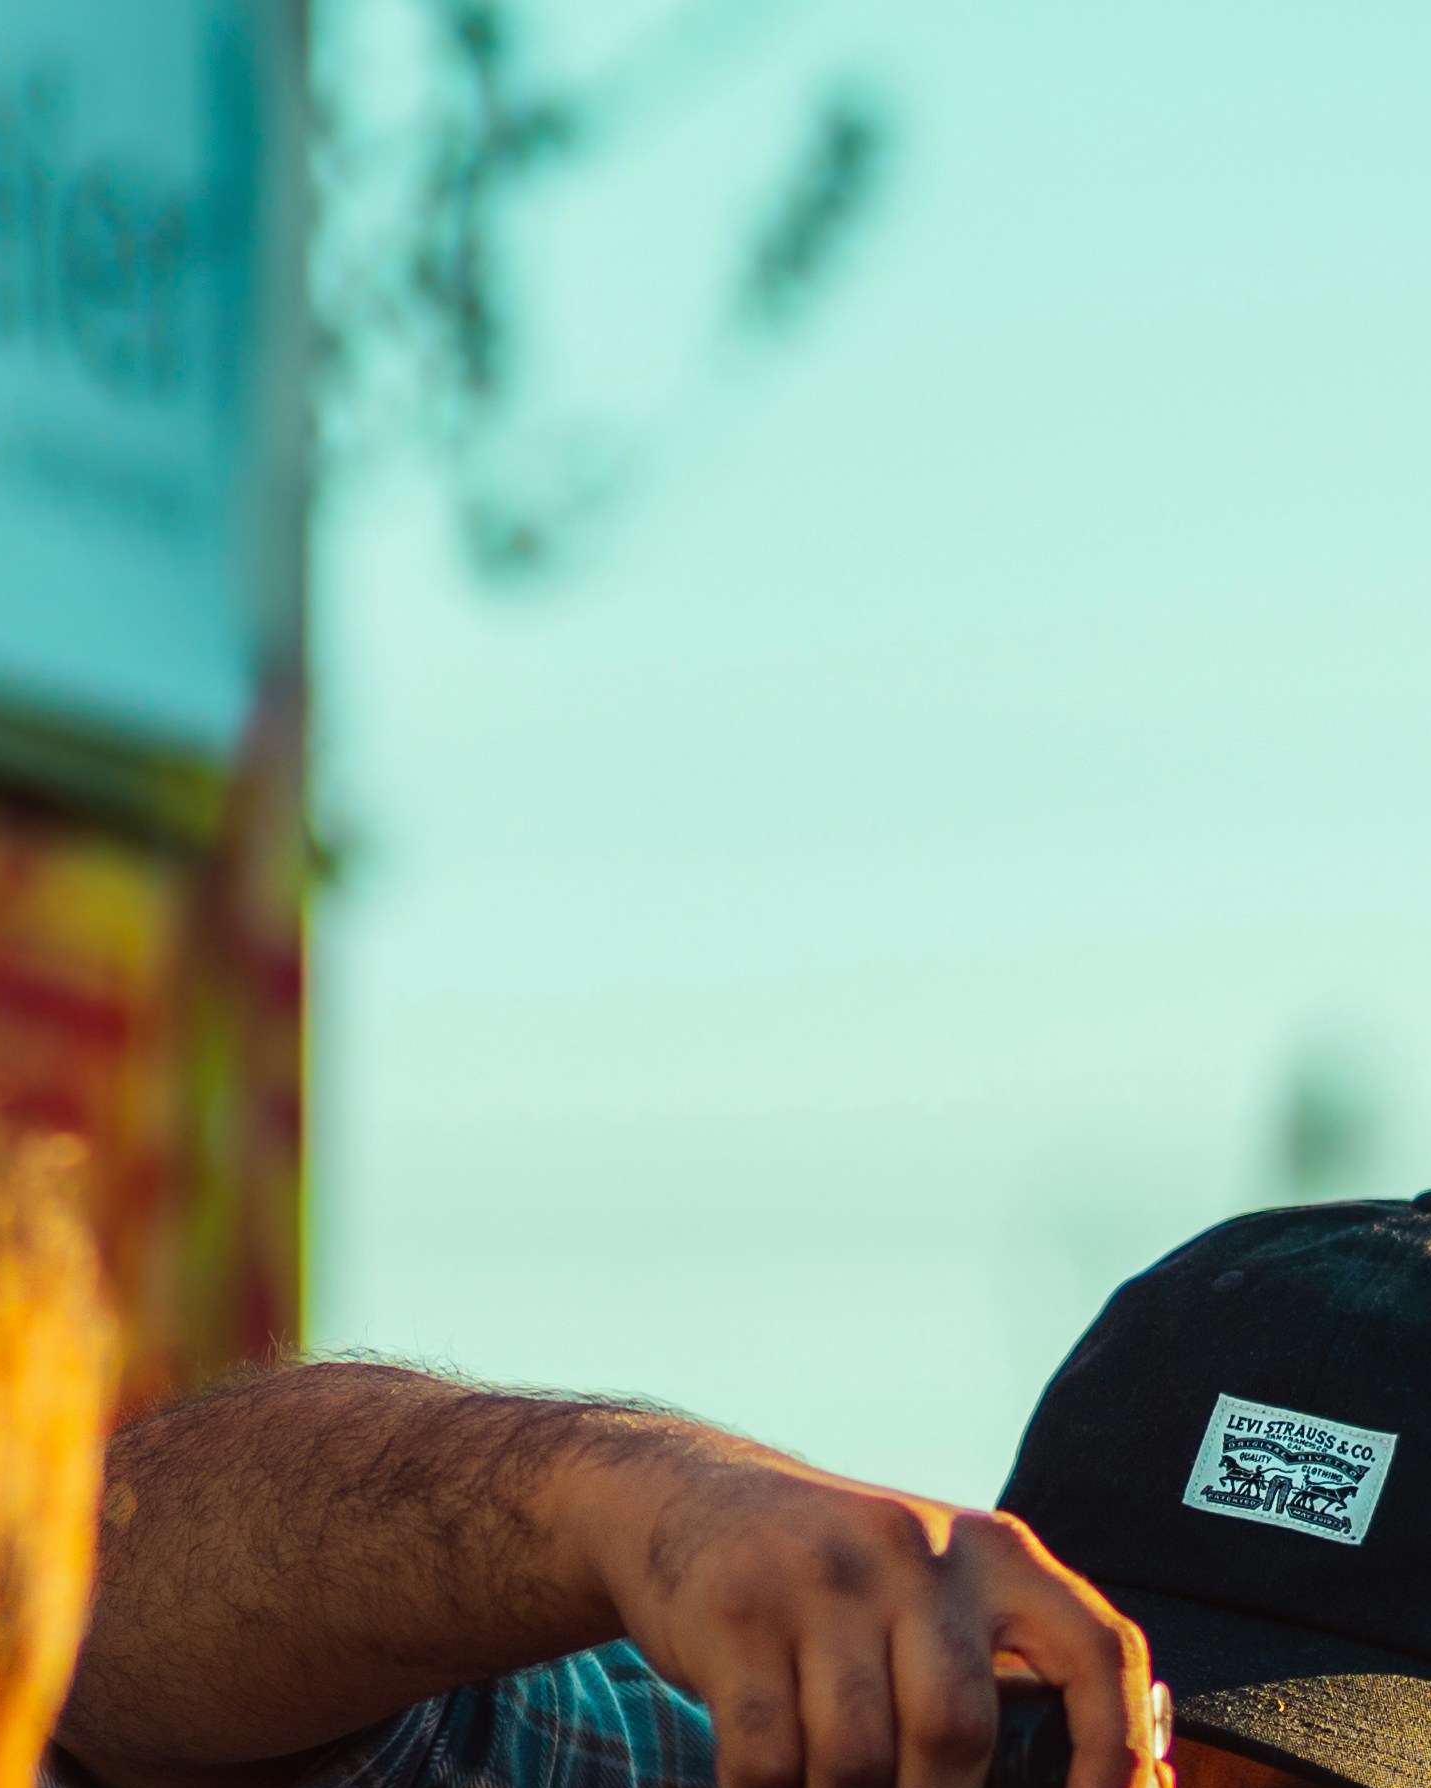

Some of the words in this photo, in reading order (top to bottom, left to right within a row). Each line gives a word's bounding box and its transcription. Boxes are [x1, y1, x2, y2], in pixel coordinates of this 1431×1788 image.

[1226, 1414, 1263, 1434] LEVI
[1264, 1421, 1337, 1450] STRAUSS
[1337, 1440, 1349, 1456] &
[1351, 1444, 1376, 1463] CO.
[1228, 1440, 1287, 1459] ORIGINAL
[1297, 1454, 1357, 1477] RIVETED
[1239, 1451, 1273, 1465] QUALITY
[1301, 1465, 1344, 1483] CLOTHING
[1292, 1509, 1312, 1519] MAY
